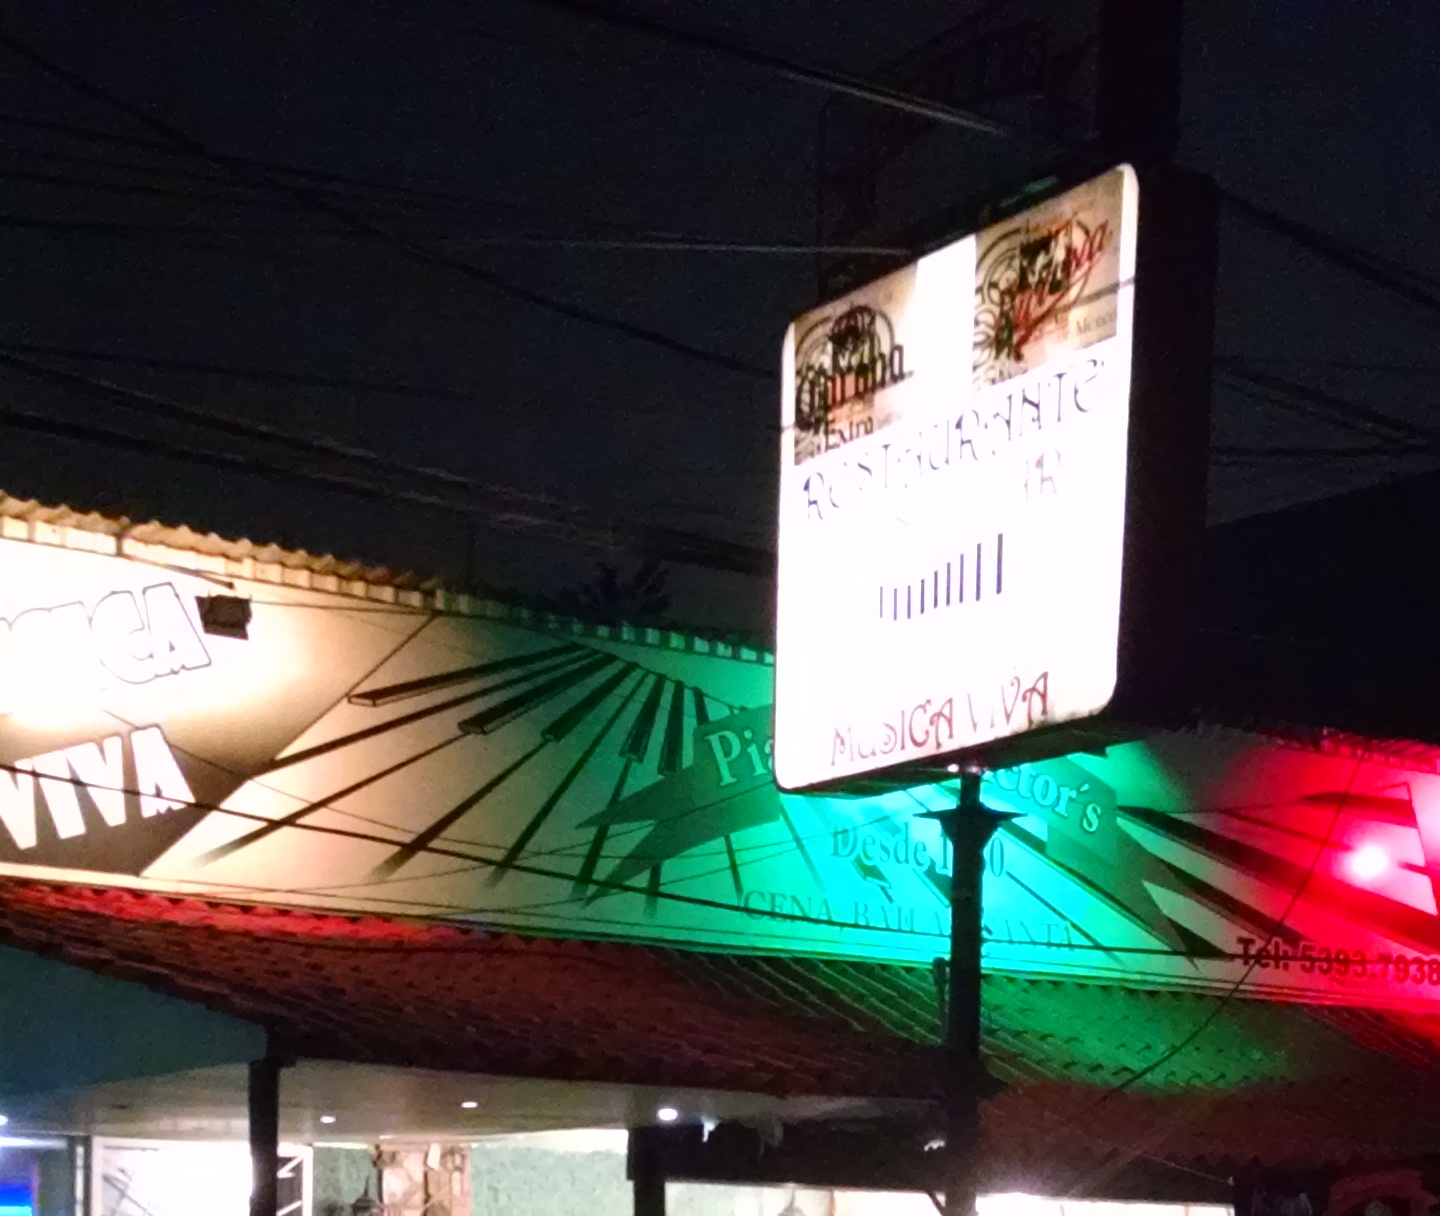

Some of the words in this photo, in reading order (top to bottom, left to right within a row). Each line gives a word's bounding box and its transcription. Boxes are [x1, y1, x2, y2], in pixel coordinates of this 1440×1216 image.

[967, 671, 1050, 735] VIVA
[829, 821, 929, 868] Desde
[938, 834, 1006, 878] 10
[1236, 936, 1291, 970] Tel:
